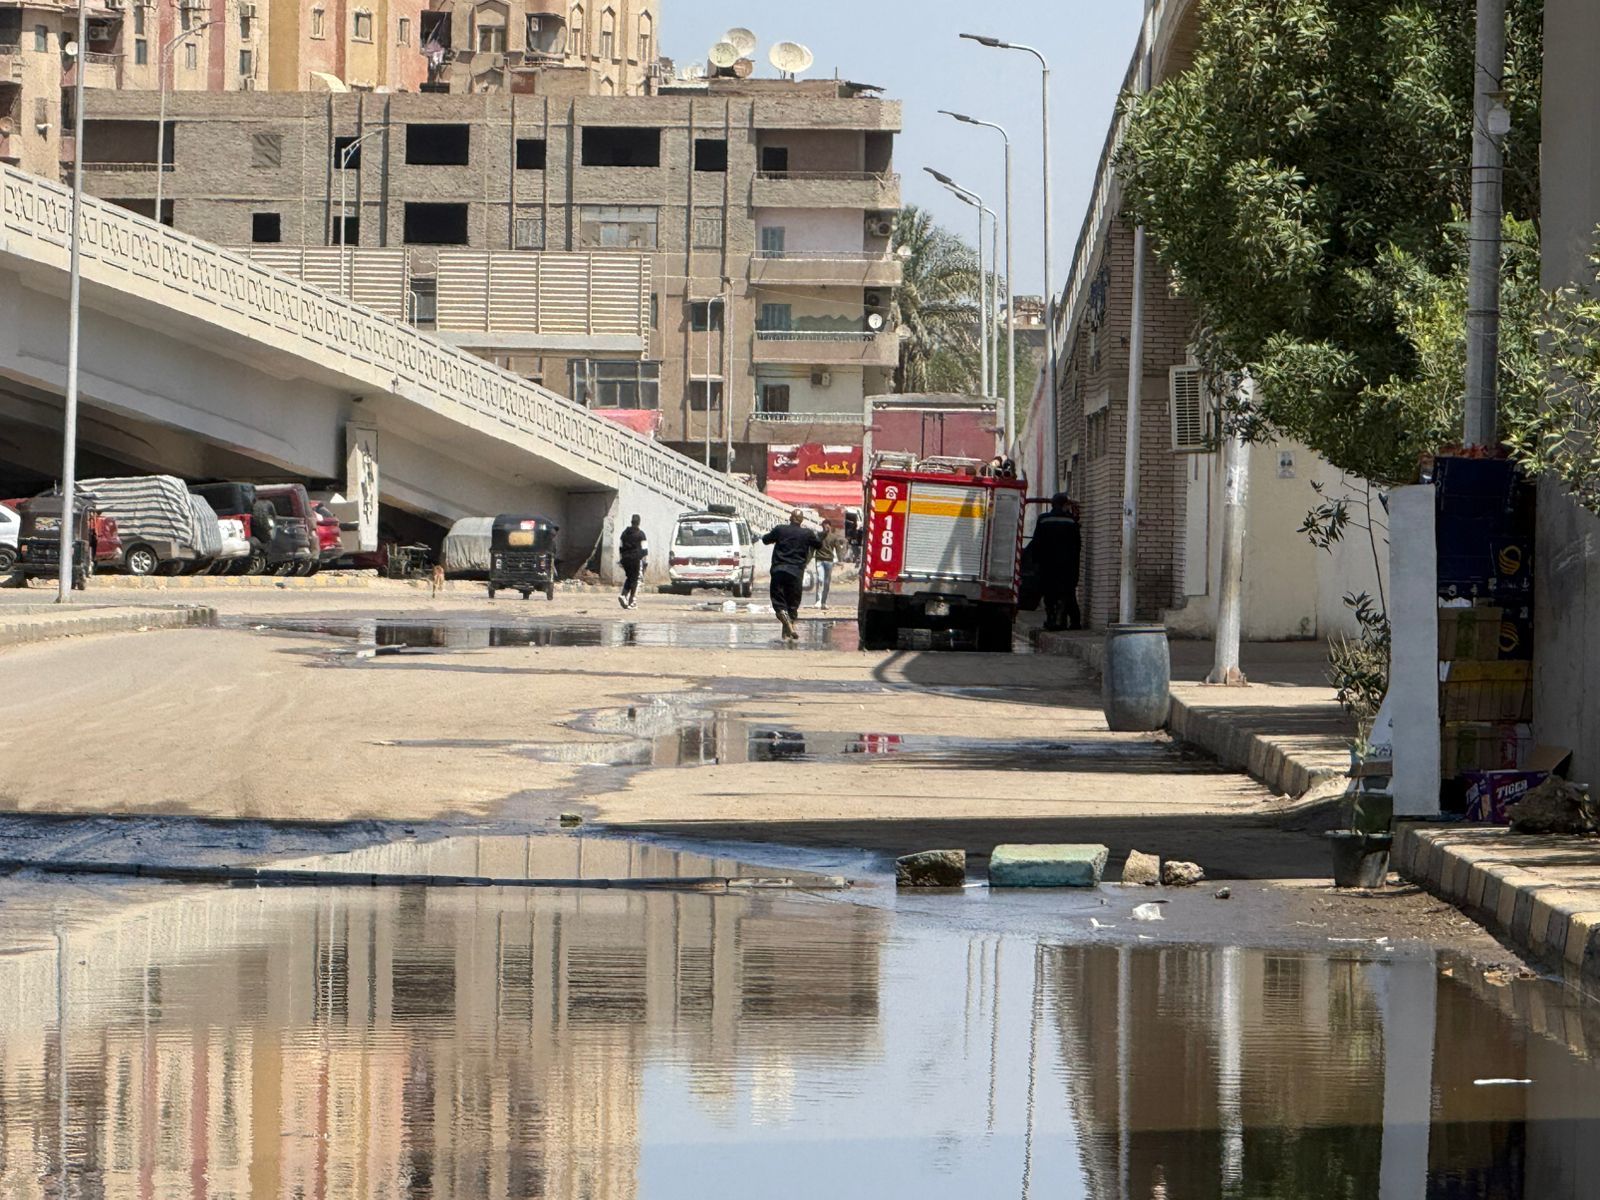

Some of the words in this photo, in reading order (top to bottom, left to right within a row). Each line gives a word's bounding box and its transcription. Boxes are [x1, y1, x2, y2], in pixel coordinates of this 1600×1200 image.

[806, 460, 857, 477] المعلم
[881, 515, 893, 562] 180
[1496, 779, 1529, 800] TIGER
